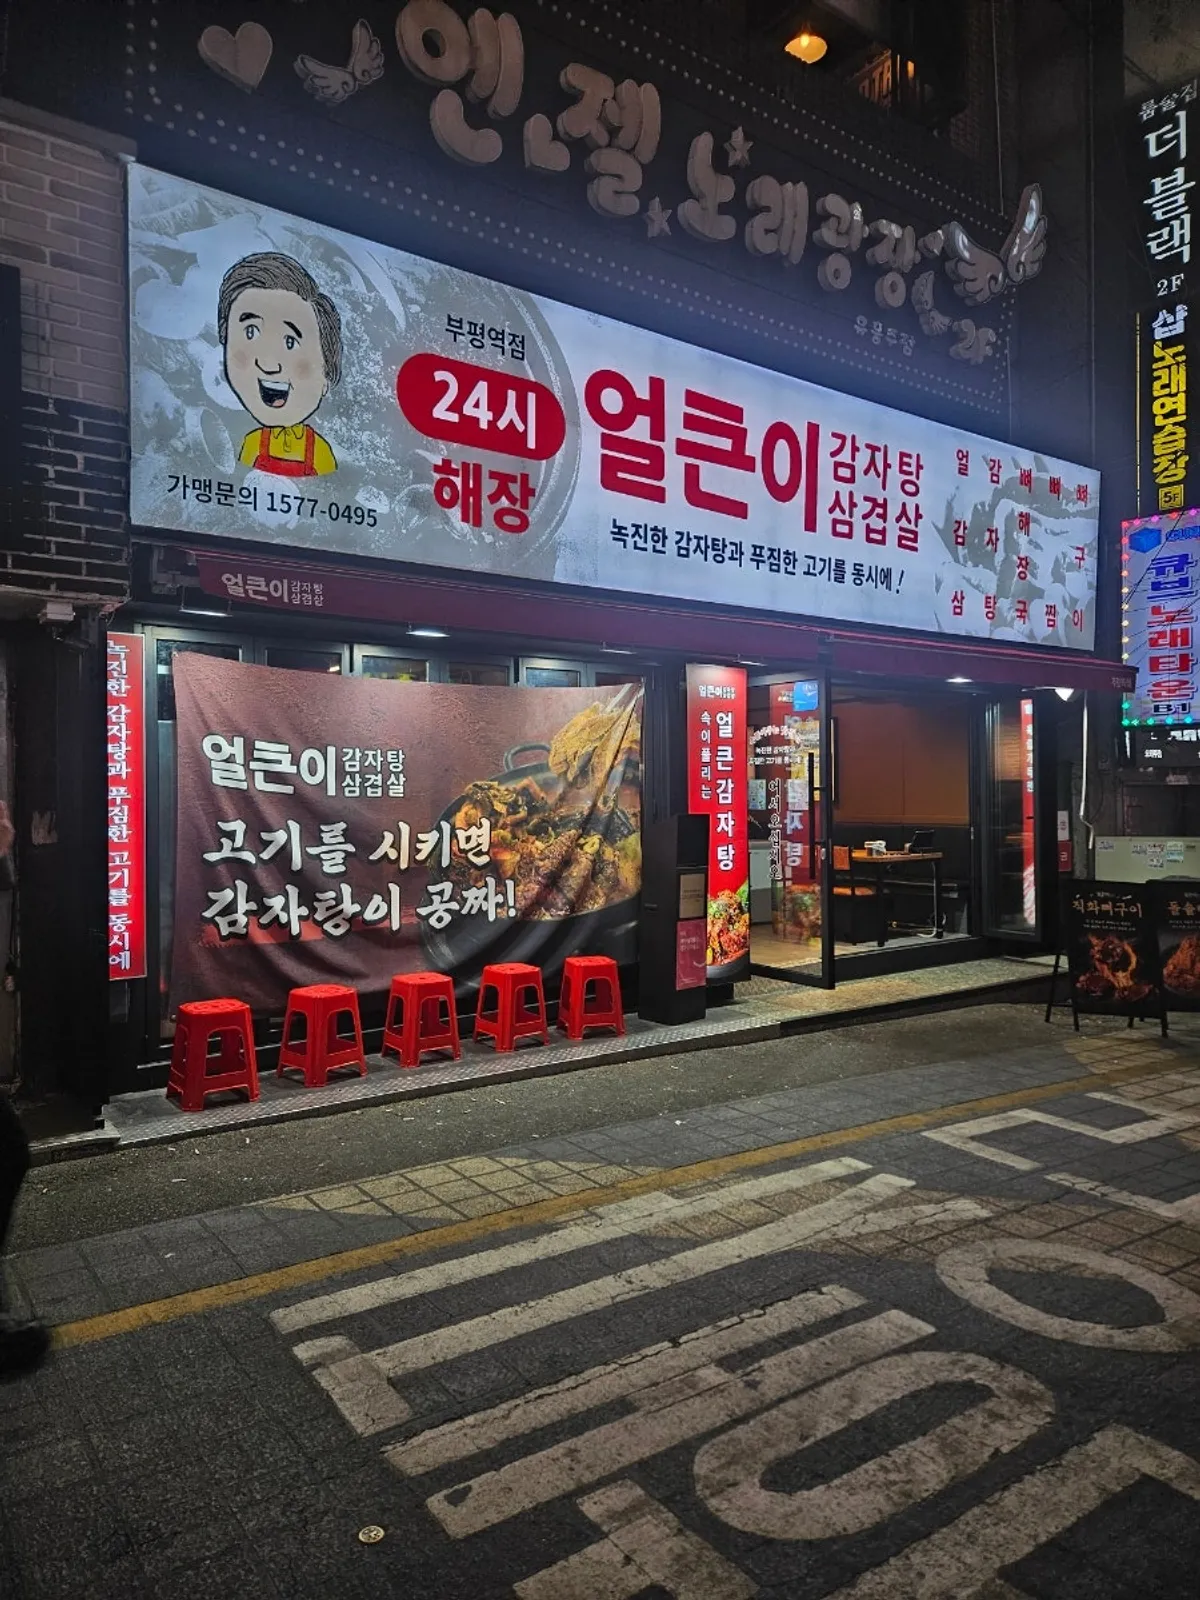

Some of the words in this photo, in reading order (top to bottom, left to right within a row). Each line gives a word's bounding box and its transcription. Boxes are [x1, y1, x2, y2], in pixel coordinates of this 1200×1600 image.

[1157, 273, 1185, 296] 2F
[445, 313, 527, 361] 부평역점
[431, 369, 537, 449] 24시
[584, 369, 820, 533] 얼큰이
[829, 431, 924, 498] 감자탕
[167, 473, 260, 512] 가맹문의
[266, 491, 379, 528] 1577-0495
[432, 458, 537, 535] 해장
[828, 490, 924, 553] 삼겹살
[610, 518, 668, 555] 녹진한
[674, 529, 745, 568] 감자탕과
[749, 543, 798, 577] 푸짐한
[802, 554, 847, 585] 고기를
[221, 573, 289, 602] 얼큰이
[107, 641, 131, 697] 녹진한
[1153, 702, 1189, 715] B1
[107, 703, 132, 780] 감자탕과
[201, 734, 336, 797] 얼큰이
[341, 748, 406, 773] 감자탕
[341, 773, 406, 798] 삼겹살
[108, 787, 132, 843] 푸짐한
[768, 778, 783, 880] 어서오십시오
[203, 819, 356, 874] 고기를
[369, 817, 493, 871] 시키면
[108, 851, 132, 907] 고기를
[202, 879, 401, 939] 감자탕이
[416, 876, 517, 931] 공짜!
[108, 913, 132, 971] 동시에
